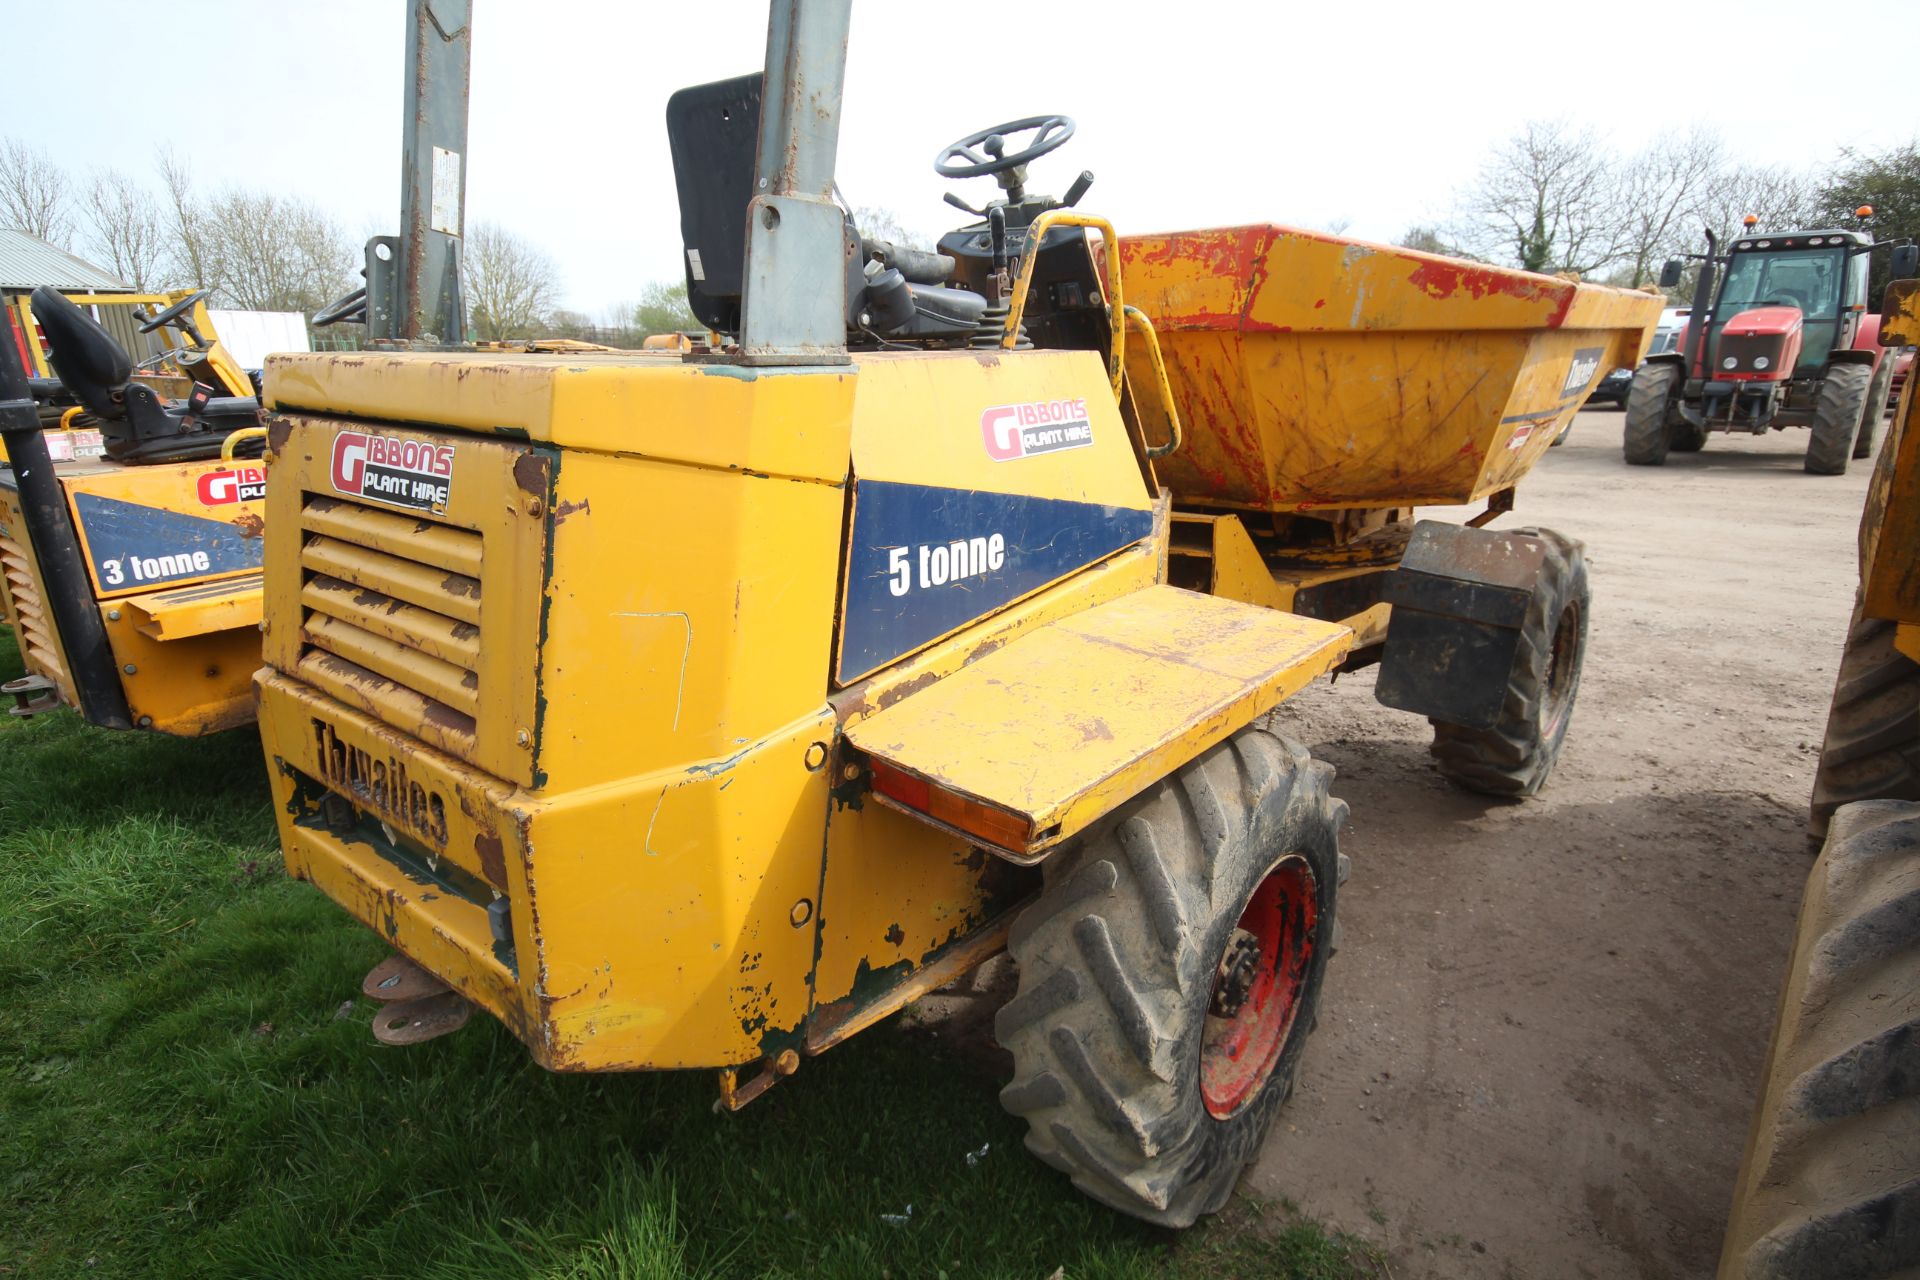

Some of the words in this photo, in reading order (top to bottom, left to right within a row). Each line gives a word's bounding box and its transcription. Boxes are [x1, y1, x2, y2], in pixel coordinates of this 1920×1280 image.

[982, 400, 1087, 460] GIBBONS
[1023, 429, 1062, 448] PLANT
[1064, 425, 1091, 442] HIRE
[333, 433, 453, 494] GIBBONS
[365, 472, 410, 496] PLANT
[411, 481, 448, 504] HIRE
[103, 559, 124, 585] 3
[130, 551, 210, 580] tonne
[889, 546, 910, 597] 5
[919, 533, 1004, 588] tonne
[311, 717, 449, 848] Thwaites
